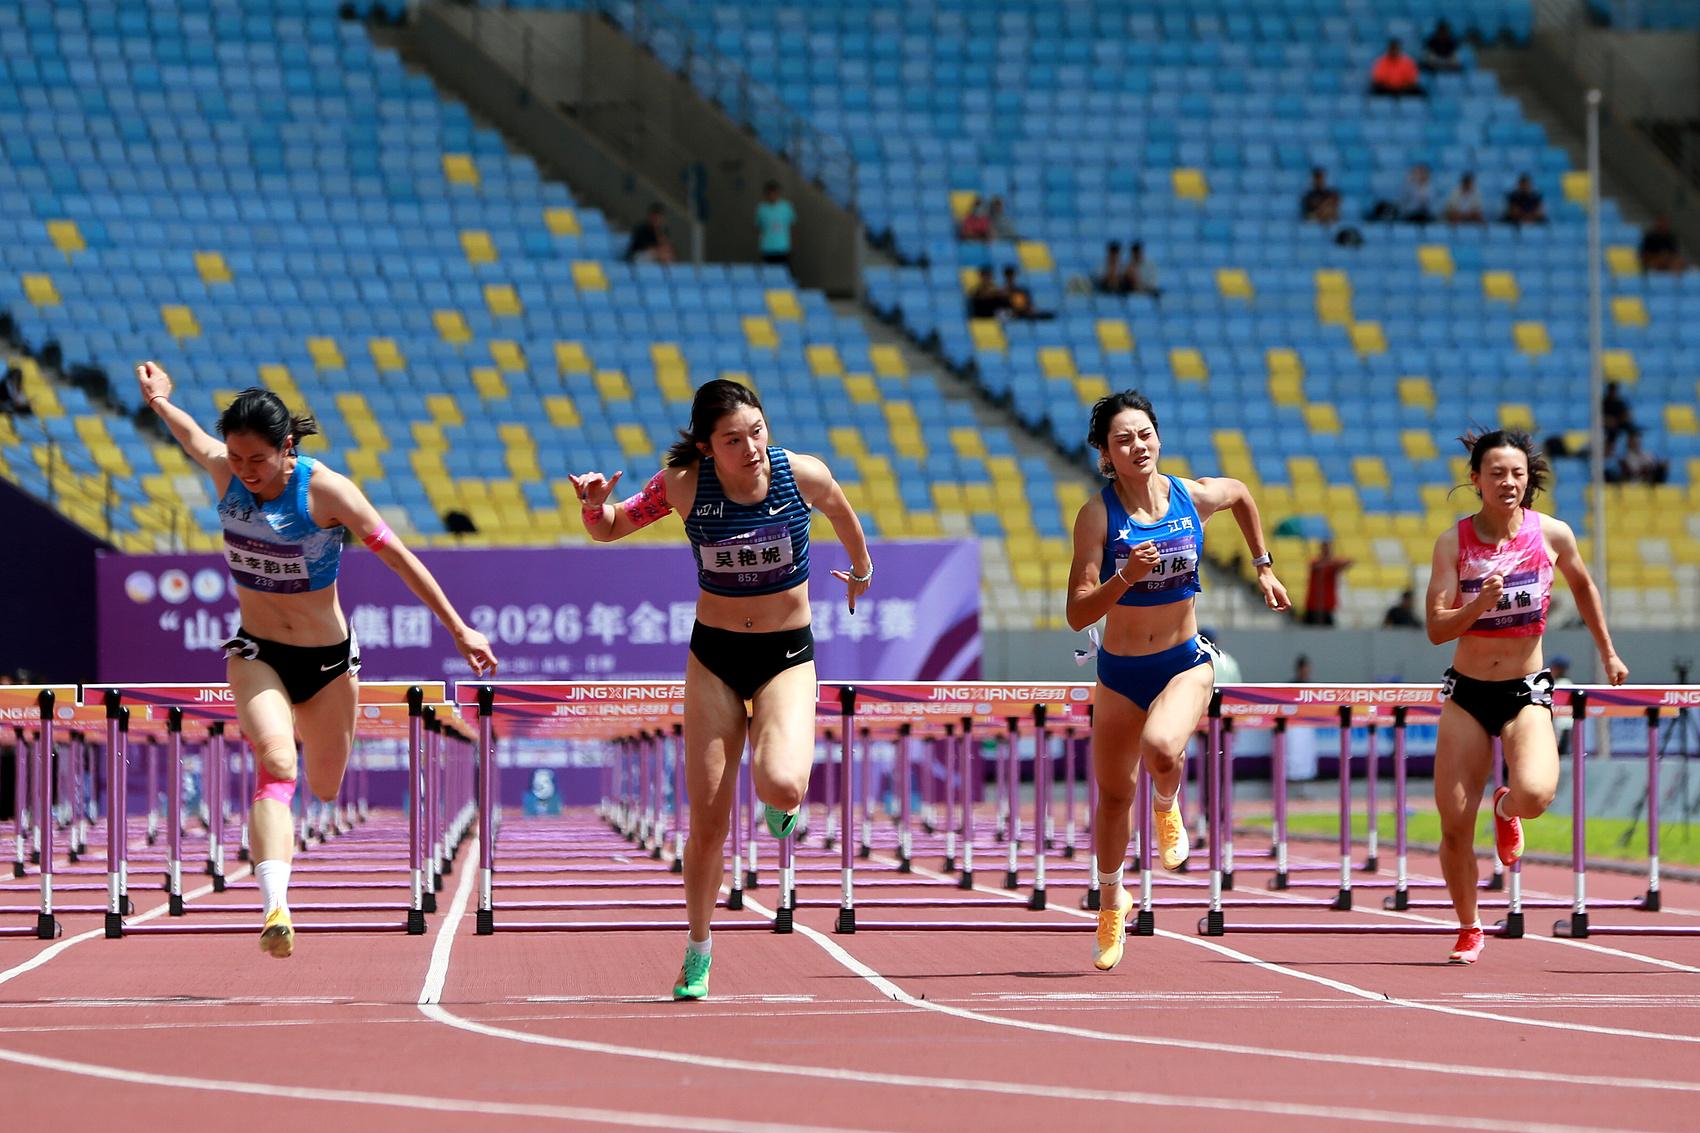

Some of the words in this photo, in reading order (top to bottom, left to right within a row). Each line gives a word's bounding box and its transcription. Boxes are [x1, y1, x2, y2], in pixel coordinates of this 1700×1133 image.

[697, 501, 724, 518] 四川
[1168, 516, 1194, 532] 江西
[715, 546, 781, 567] 吴艳妮
[738, 573, 758, 582] 852
[1490, 590, 1531, 612] 嘉愉
